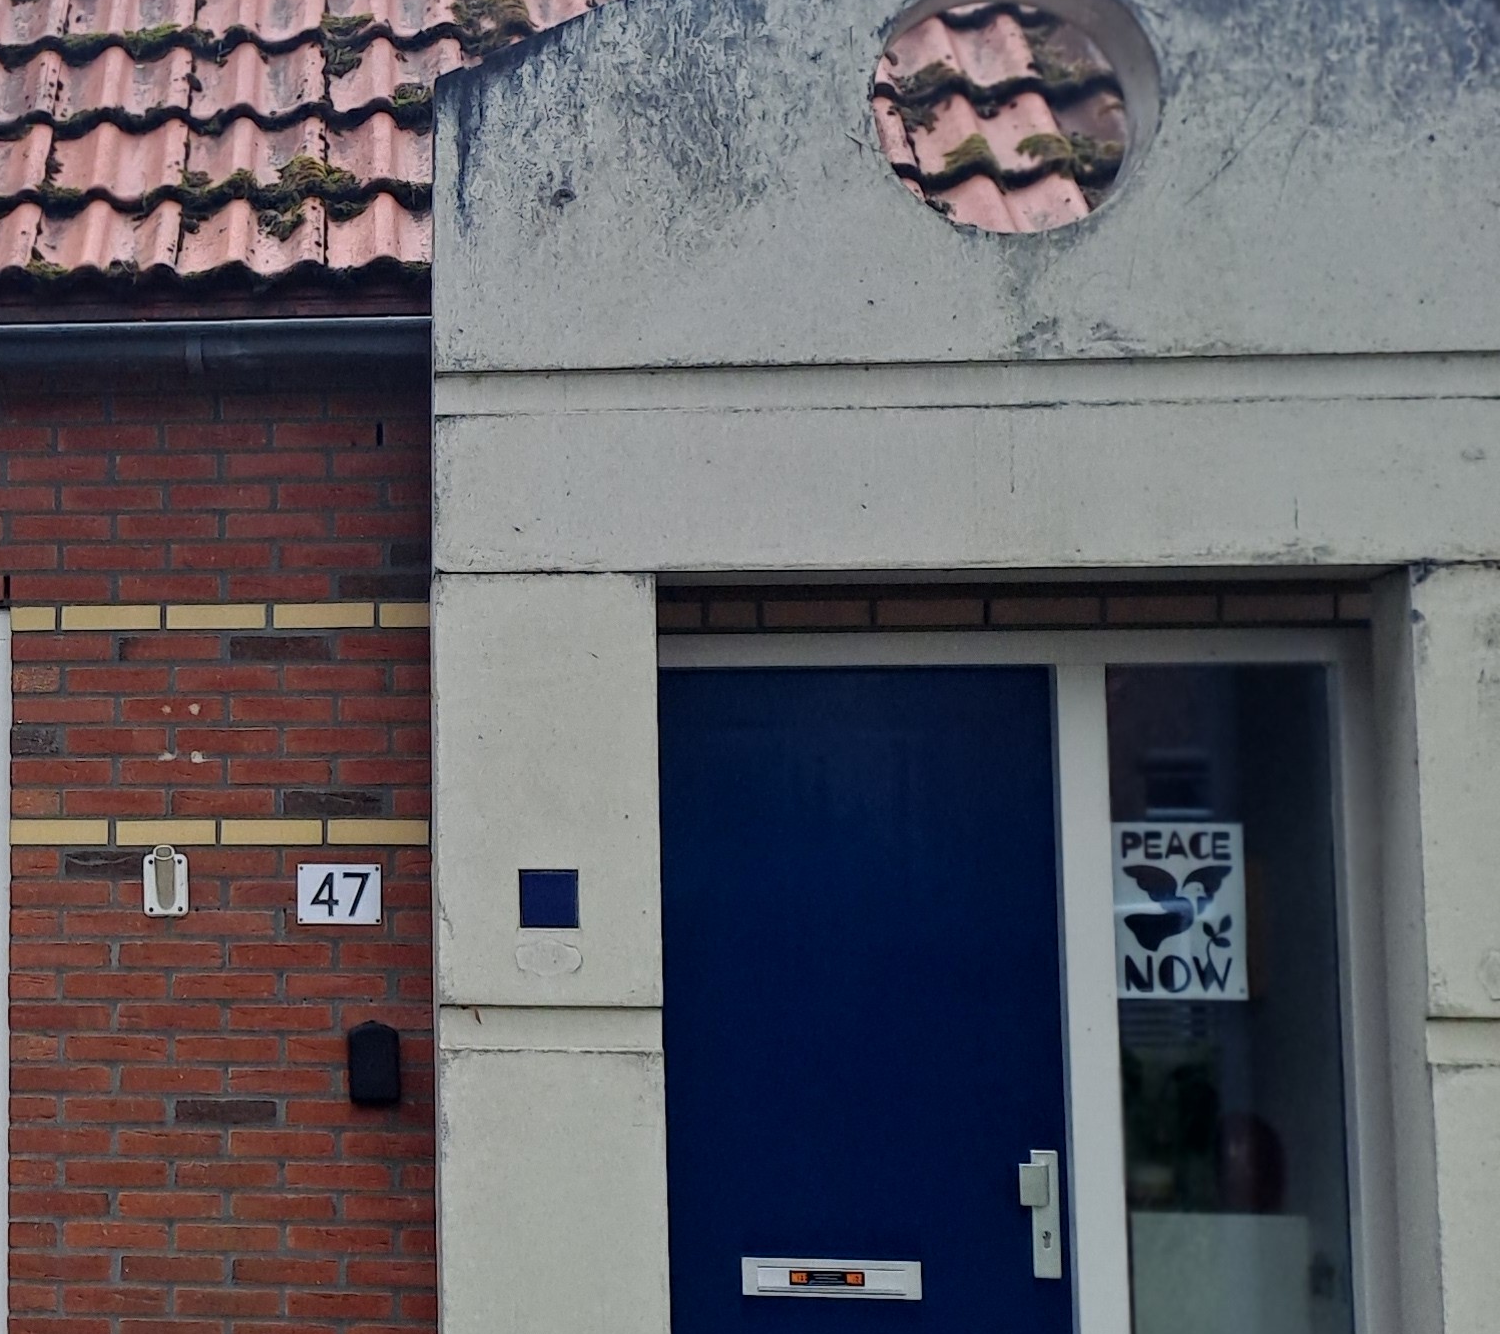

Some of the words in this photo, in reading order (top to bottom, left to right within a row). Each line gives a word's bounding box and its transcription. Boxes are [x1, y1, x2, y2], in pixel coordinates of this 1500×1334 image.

[1121, 830, 1232, 861] PEACE
[310, 871, 371, 917] 47
[1124, 954, 1233, 994] NOW
